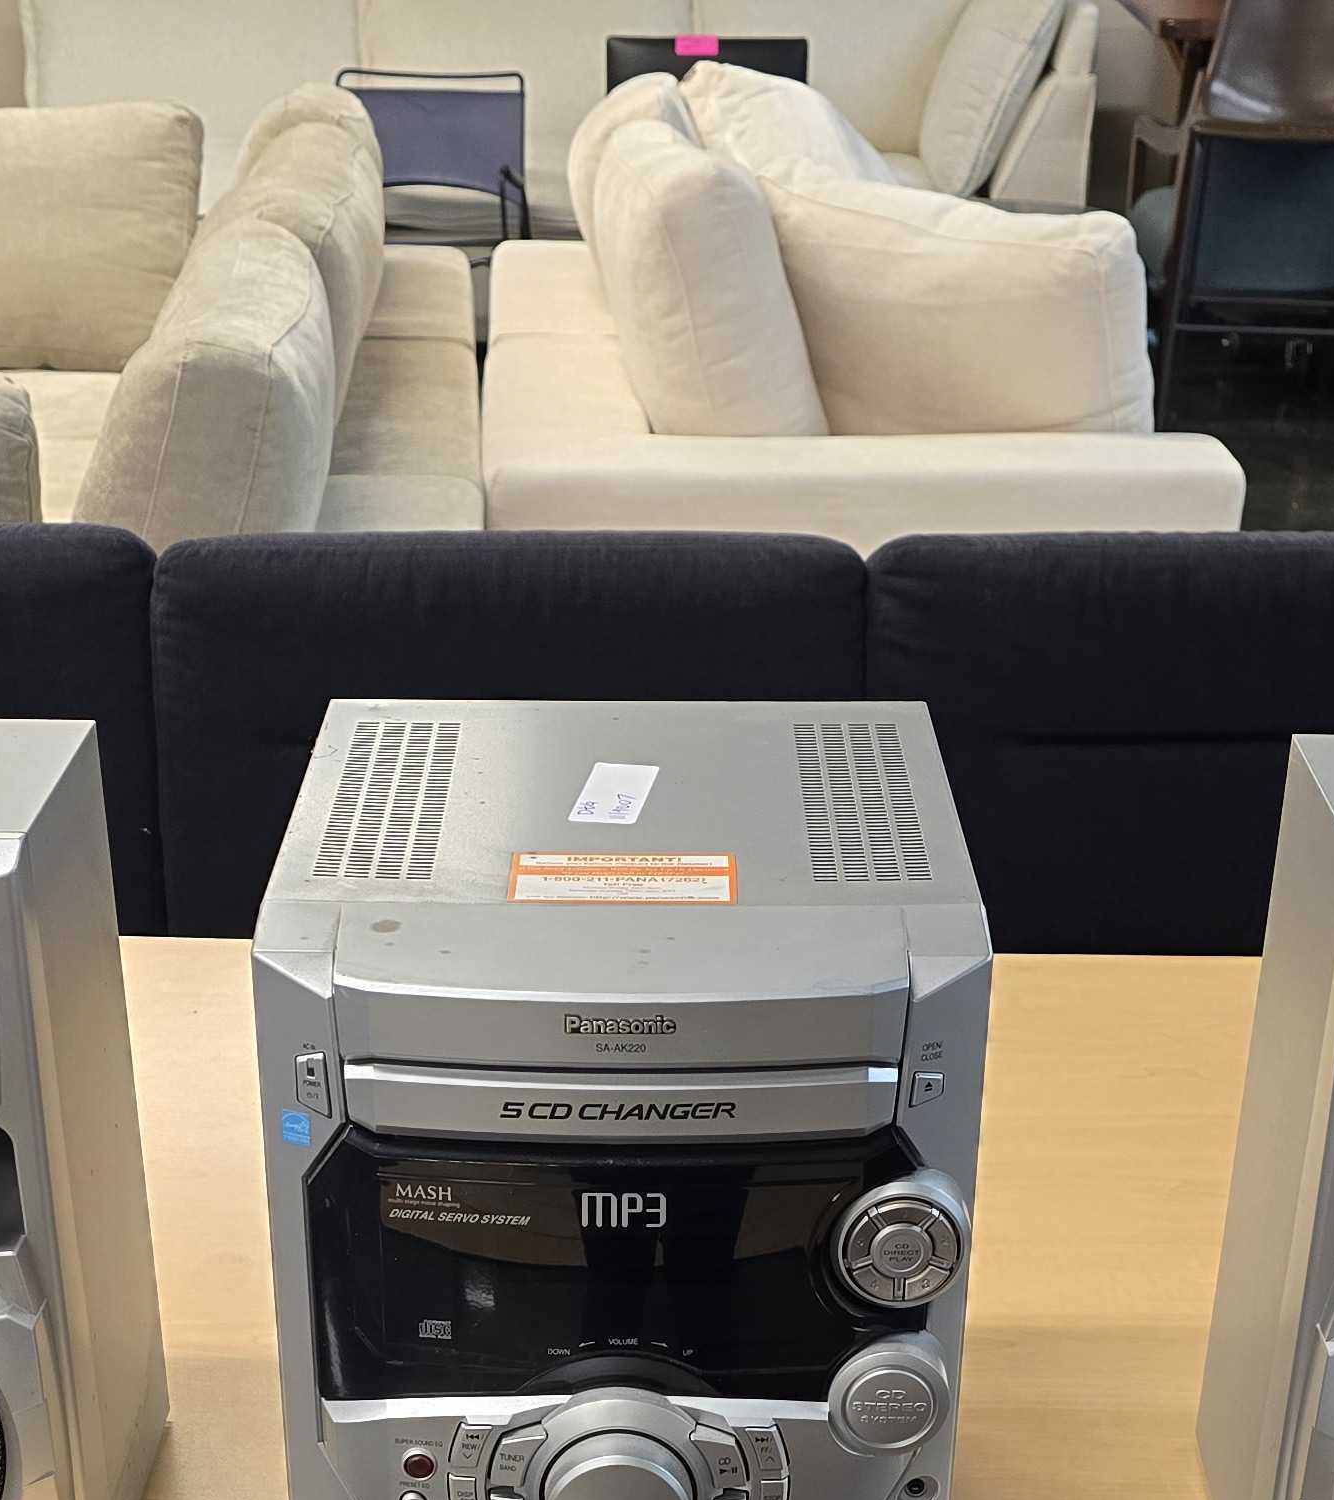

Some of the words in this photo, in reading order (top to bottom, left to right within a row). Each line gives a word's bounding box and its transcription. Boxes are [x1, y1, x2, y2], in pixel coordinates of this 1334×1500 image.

[564, 1014, 677, 1034] Panasonic
[595, 1043, 647, 1052] SA-AK220
[500, 1101, 525, 1119] 5
[527, 1102, 573, 1120] CD
[578, 1102, 737, 1120] CHANGER
[395, 1183, 452, 1201] MASH
[388, 1208, 435, 1221] DIGITAL
[437, 1212, 480, 1224] SERVO
[480, 1214, 531, 1226] SYSTEM
[875, 1389, 907, 1399] CD
[499, 1453, 525, 1462] TUNER
[718, 1457, 732, 1466] CD
